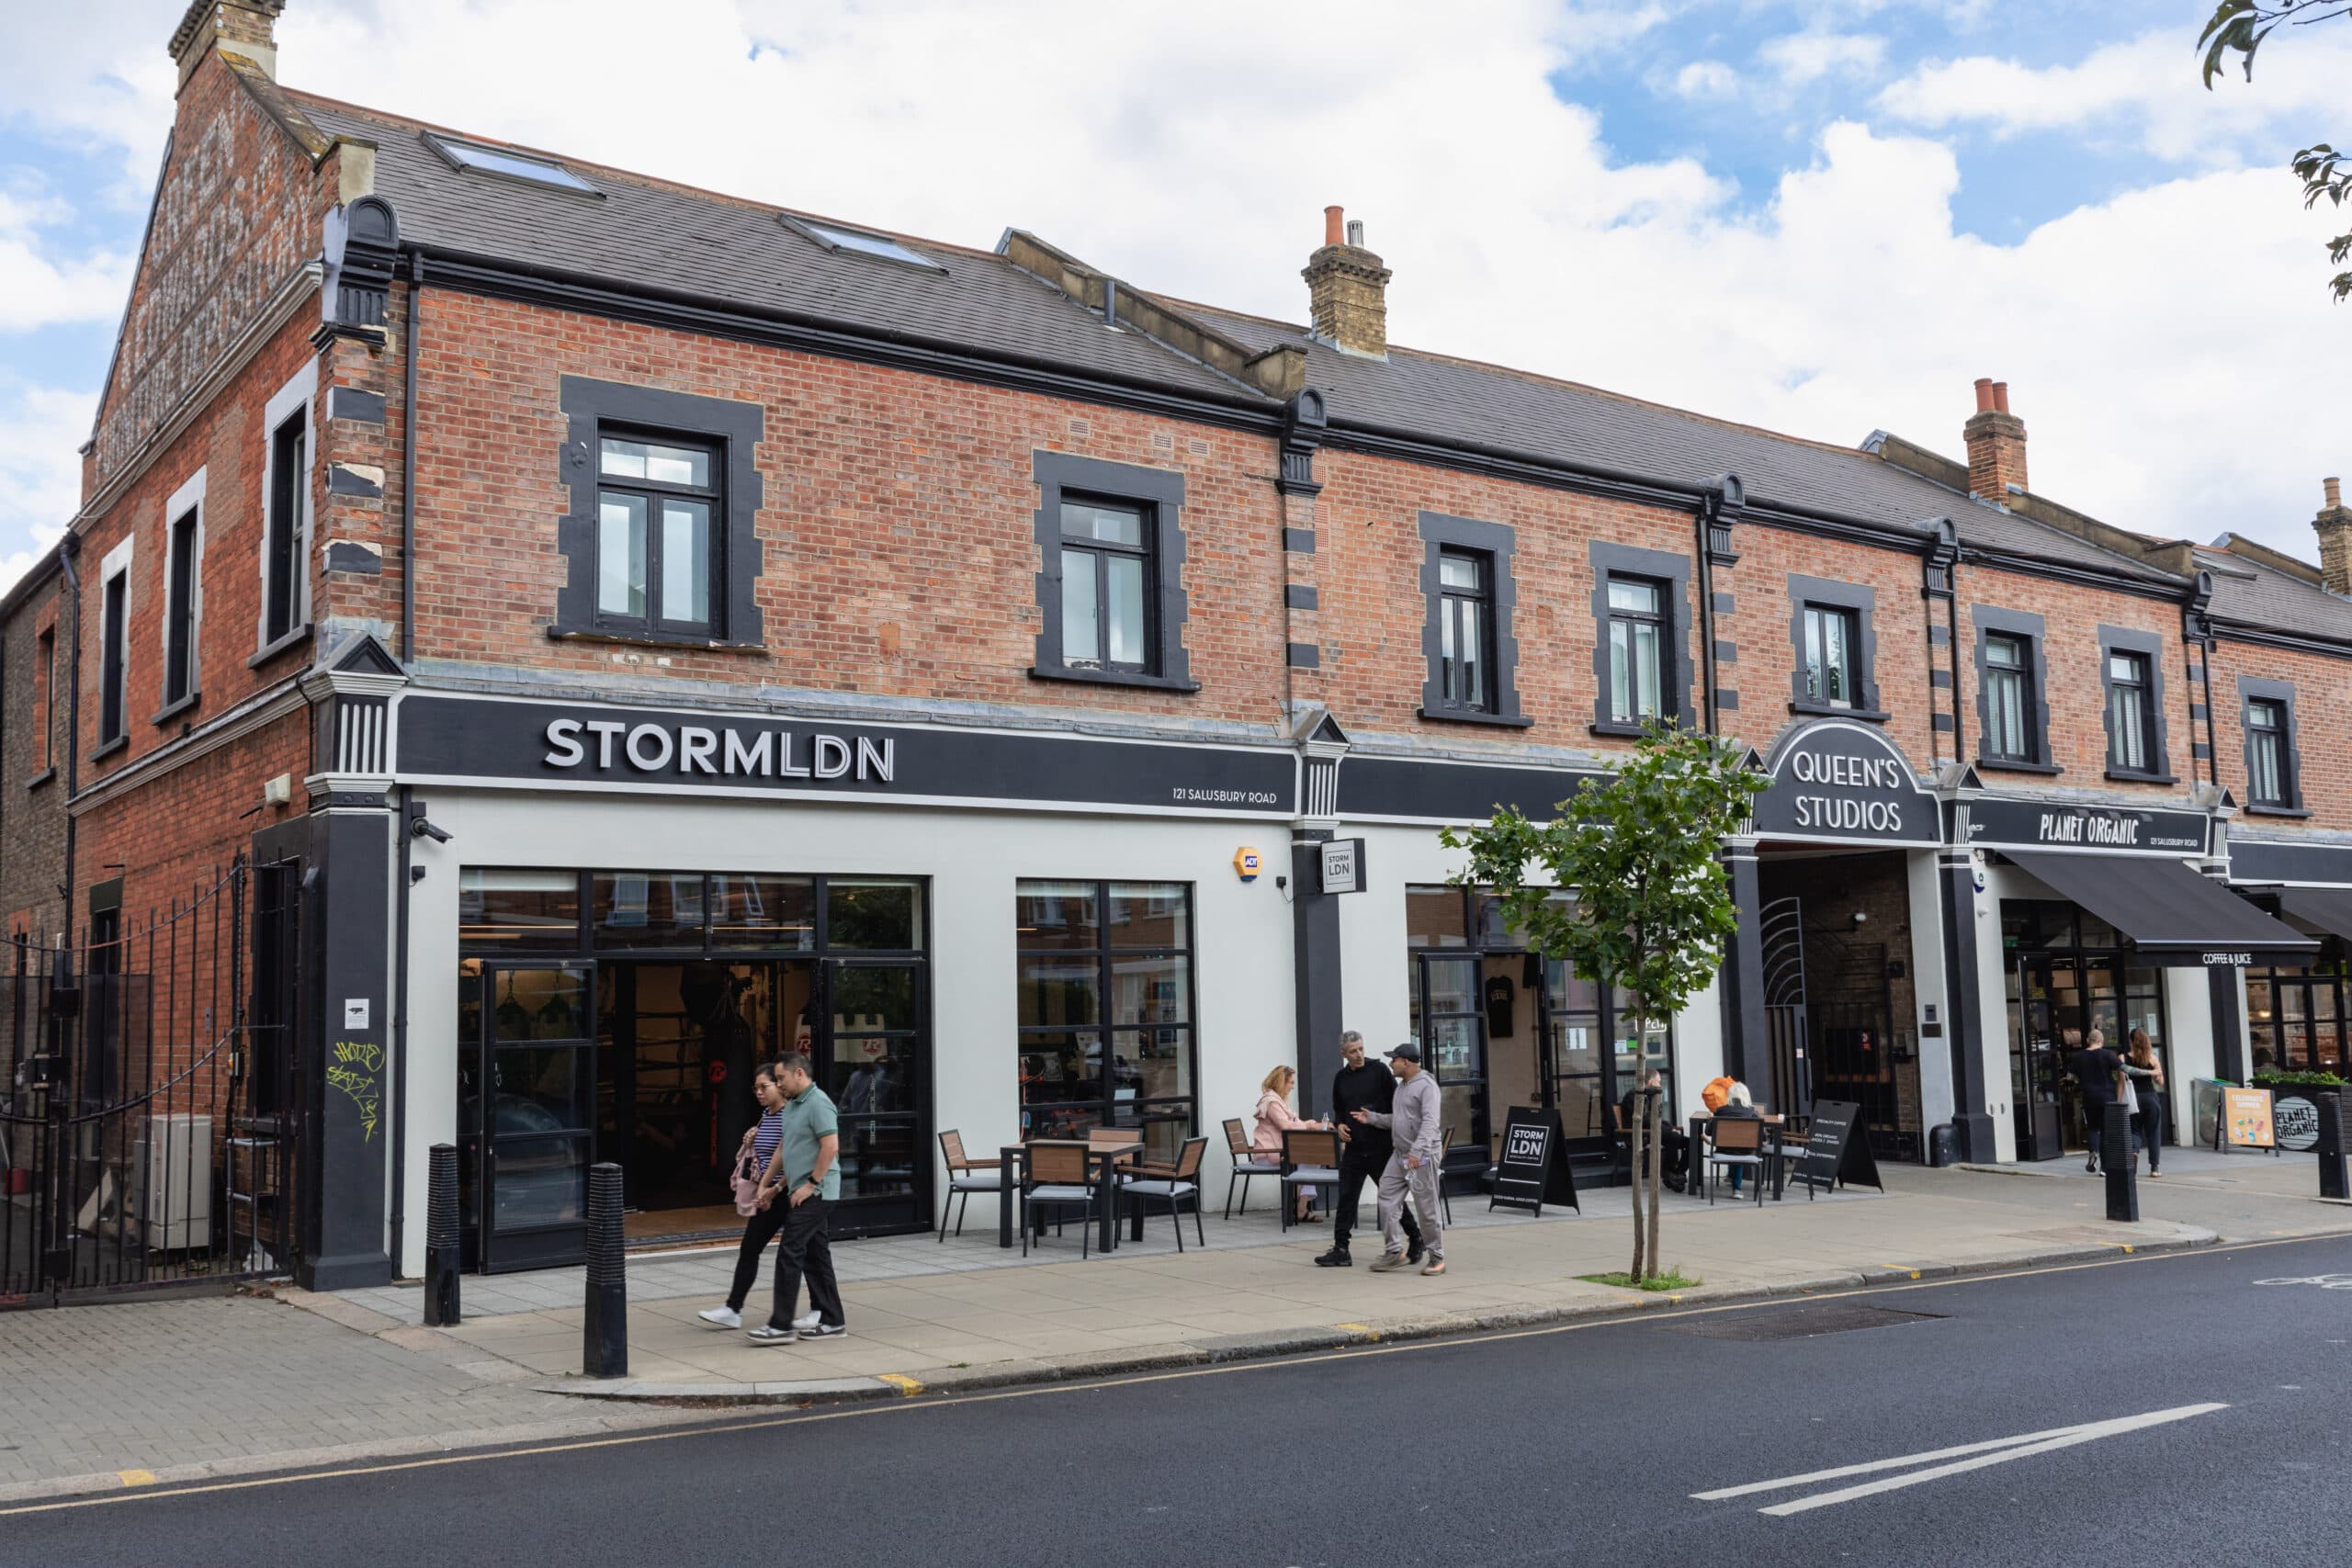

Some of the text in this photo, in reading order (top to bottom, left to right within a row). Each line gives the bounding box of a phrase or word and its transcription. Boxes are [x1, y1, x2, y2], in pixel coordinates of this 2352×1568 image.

[1792, 750, 1900, 789] QUEEN'S
[1172, 787, 1277, 804] 121 SALUSBURY ROAD
[1794, 795, 1902, 831] STUDIOS
[2040, 814, 2140, 845] PLANET ORGANIC
[2157, 838, 2184, 847] SALUSBURY
[1245, 856, 1258, 867] ADT
[1329, 854, 1349, 863] STORM
[1329, 863, 1350, 875] LDN
[2202, 953, 2252, 966] COFFEE & JUICE
[2277, 1107, 2312, 1124] PLANET
[1513, 1129, 1544, 1140] STORM
[2277, 1119, 2319, 1138] ORGANIC
[1510, 1140, 1543, 1156] LDN
